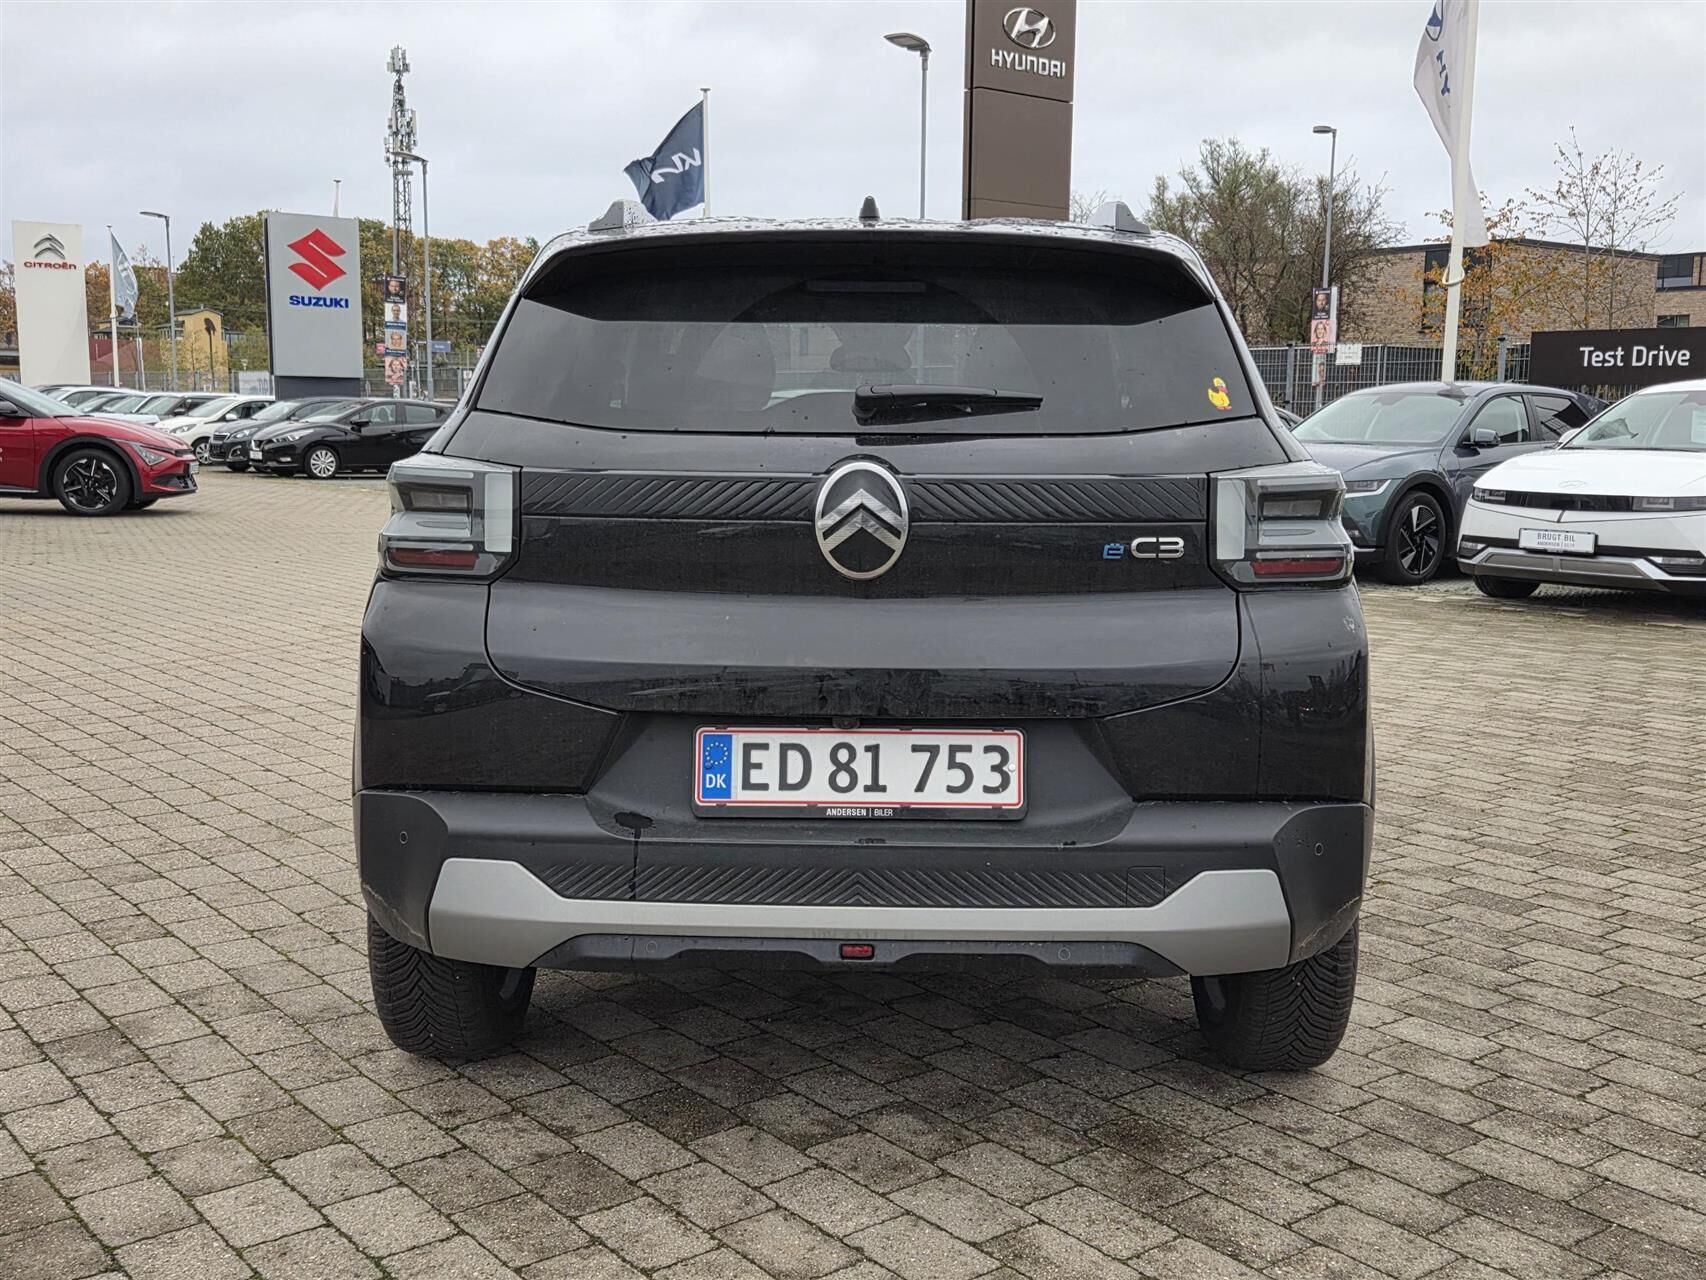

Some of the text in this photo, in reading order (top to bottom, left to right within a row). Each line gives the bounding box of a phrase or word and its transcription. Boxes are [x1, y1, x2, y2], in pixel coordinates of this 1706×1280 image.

[991, 48, 1066, 78] HYUNDAI
[288, 295, 349, 309] SUZUKI
[1579, 344, 1691, 367] Test Drive
[741, 741, 1011, 795] ED 81 753
[705, 774, 727, 788] DK
[826, 808, 893, 817] ANDERSEN BILER
